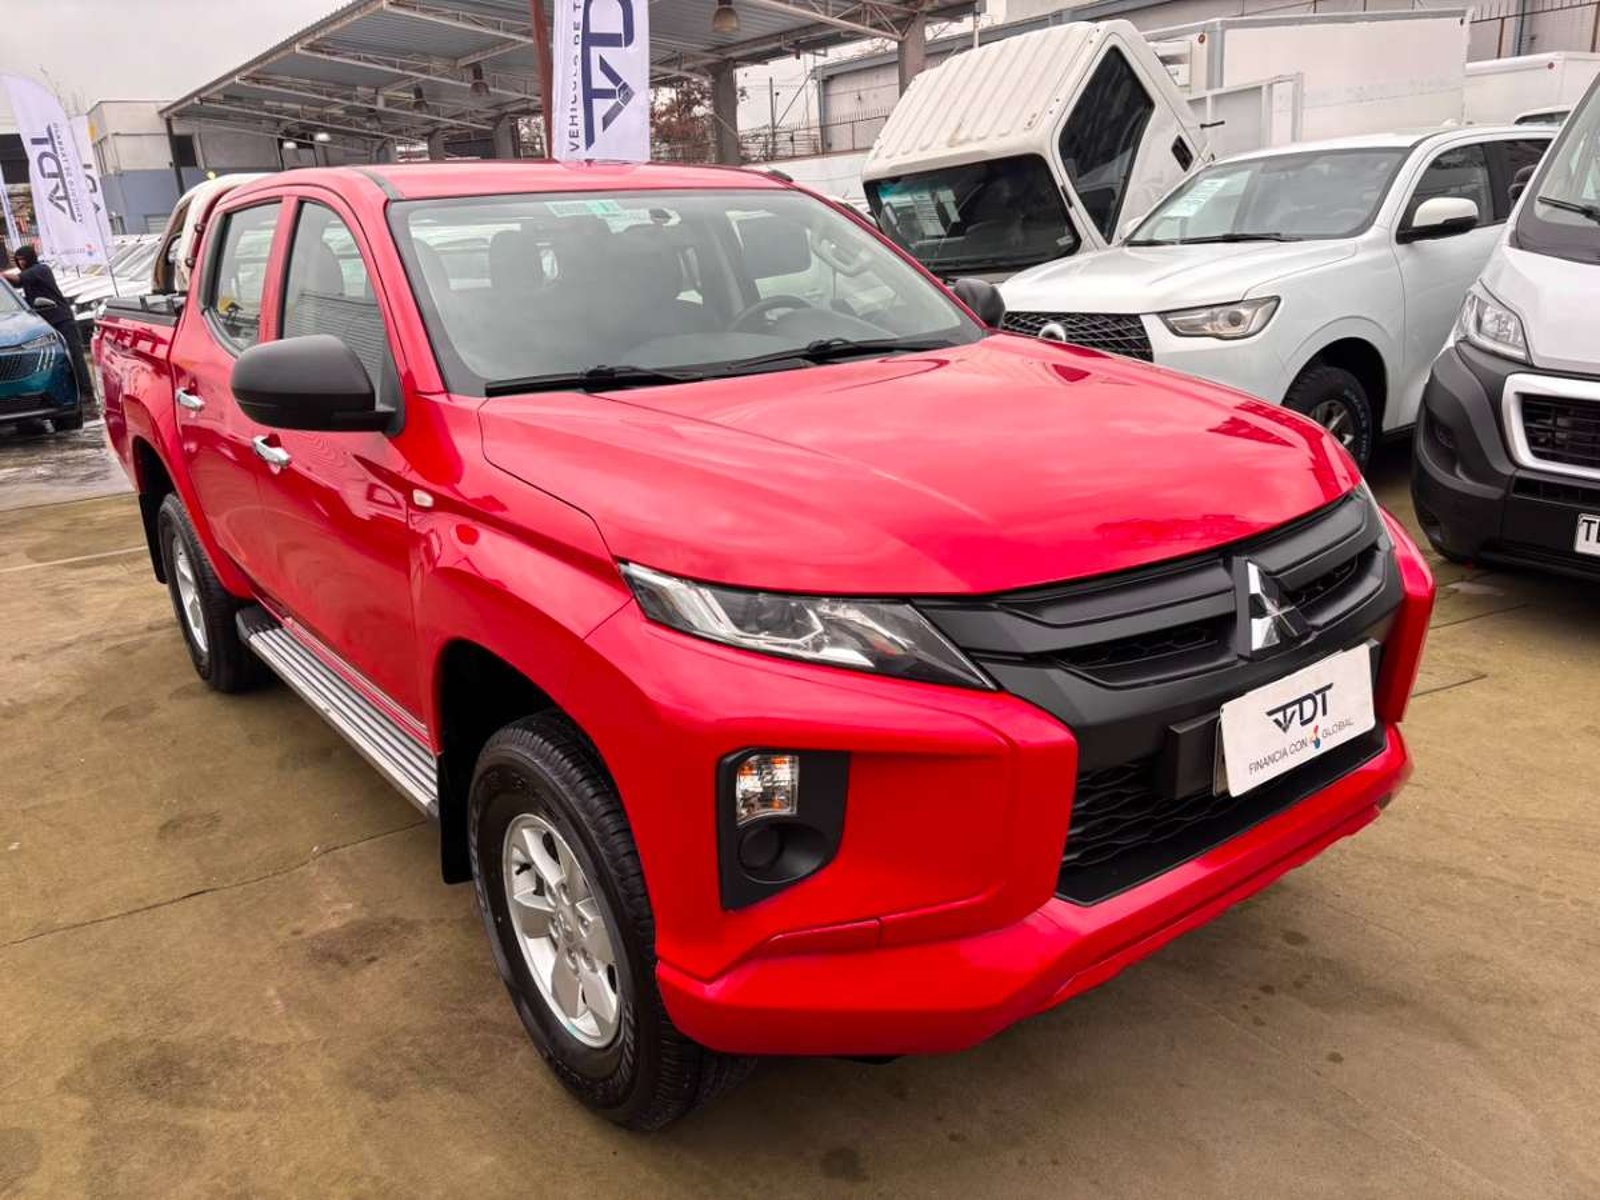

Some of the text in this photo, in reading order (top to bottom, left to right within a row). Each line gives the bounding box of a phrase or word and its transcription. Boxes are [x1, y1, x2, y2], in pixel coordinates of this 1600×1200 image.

[1248, 719, 1355, 776] FINANCIA CON GLOBAL
